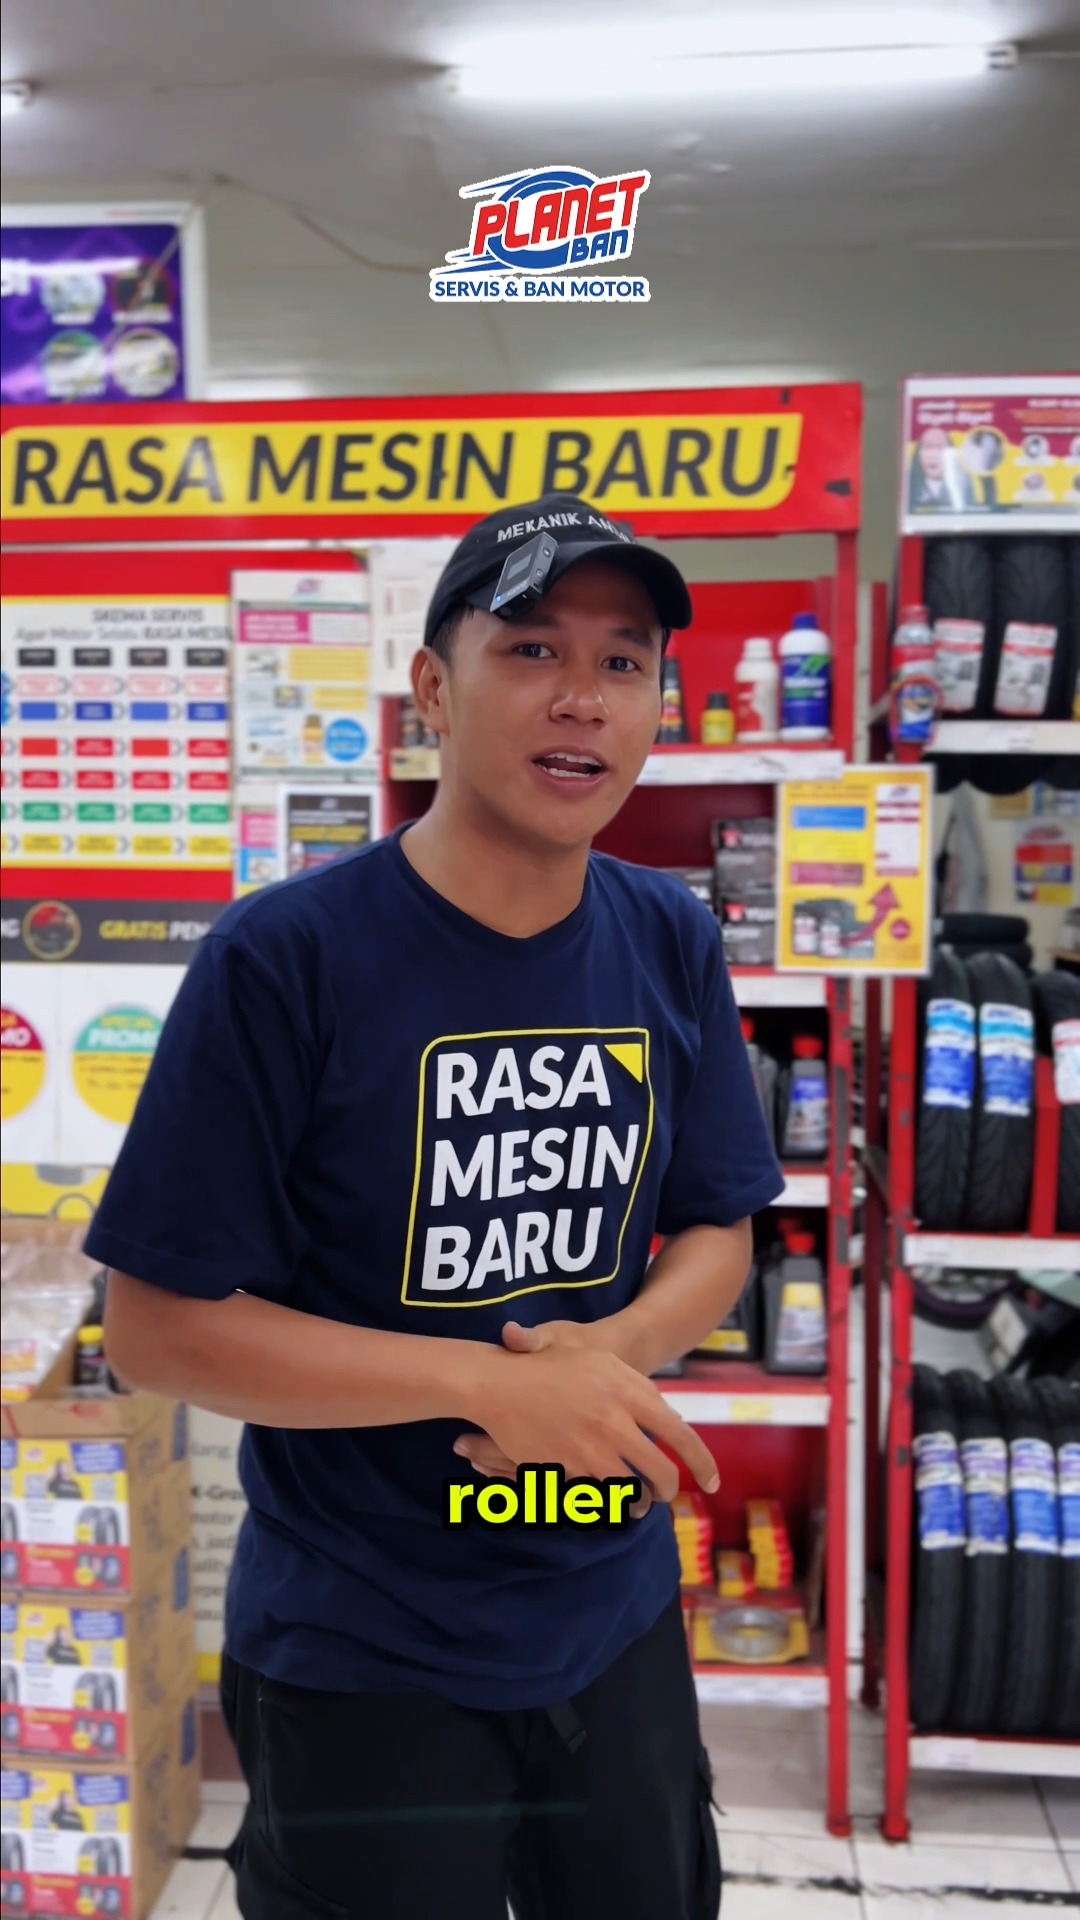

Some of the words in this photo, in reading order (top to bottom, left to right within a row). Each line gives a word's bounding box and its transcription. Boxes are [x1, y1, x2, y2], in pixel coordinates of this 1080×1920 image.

[12, 436, 225, 507] RASA
[247, 430, 516, 503] MESIN
[539, 427, 781, 499] BARU
[497, 512, 582, 543] MEKANIK
[99, 919, 168, 940] GRATIS
[88, 1028, 161, 1048] PROM
[436, 1045, 612, 1119] RASA
[430, 1124, 640, 1207] MESIN
[421, 1207, 603, 1291] BARU
